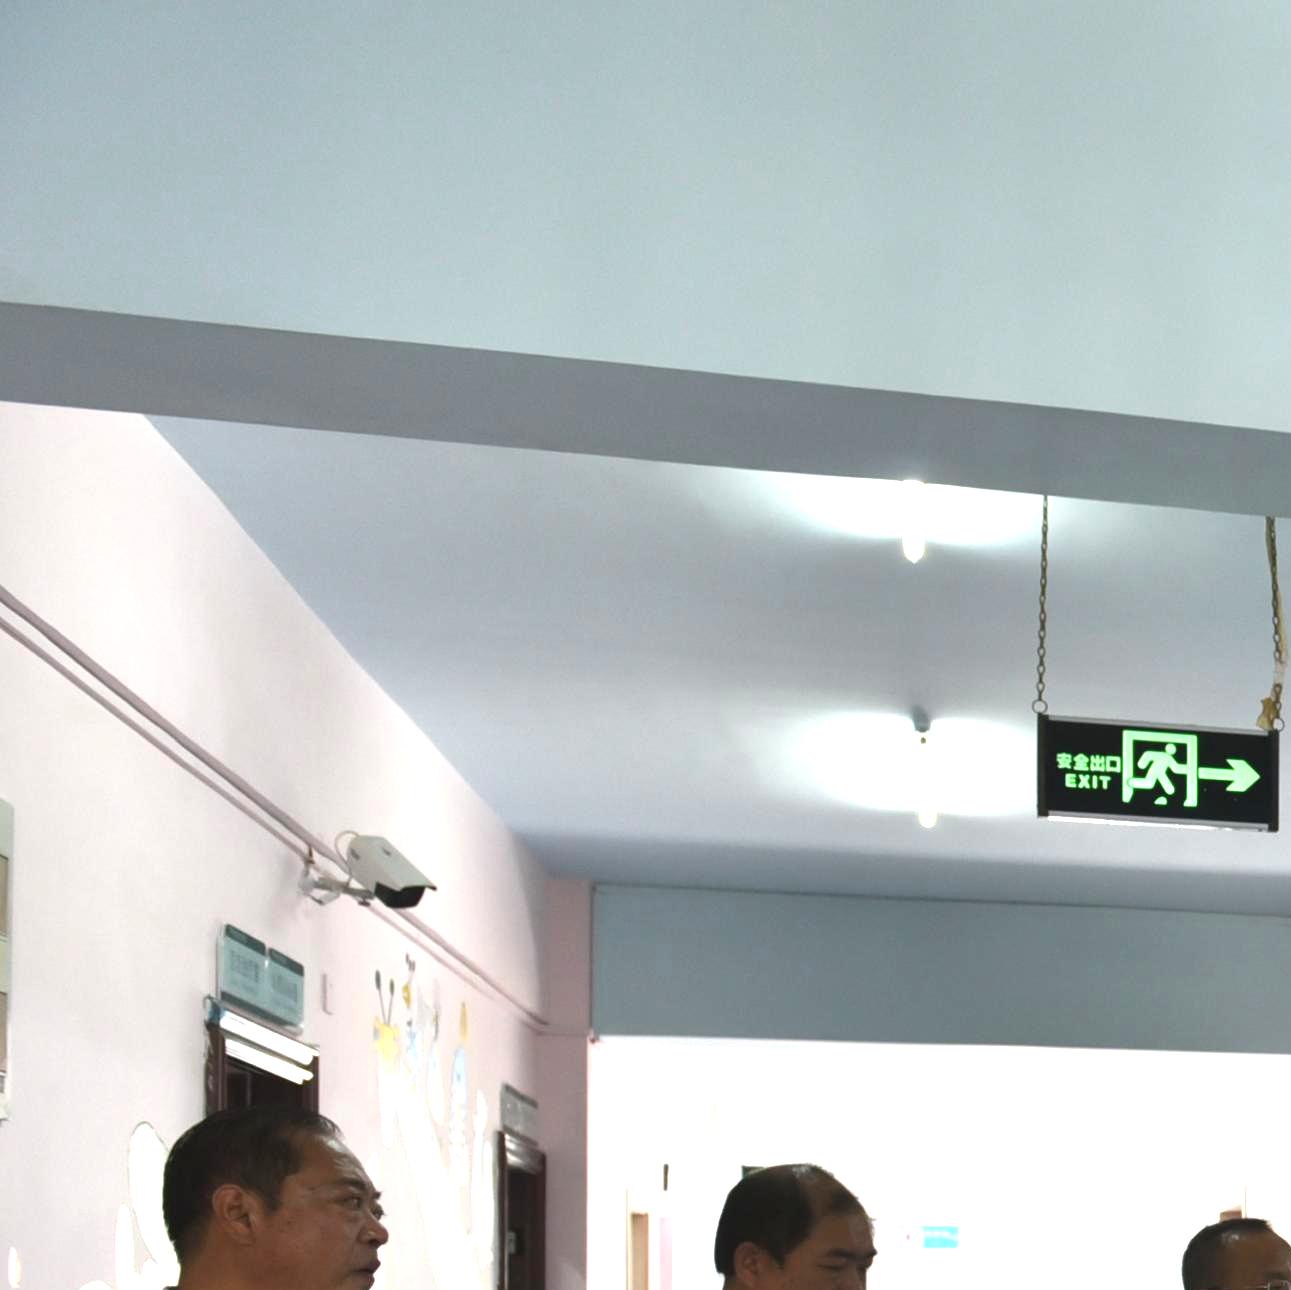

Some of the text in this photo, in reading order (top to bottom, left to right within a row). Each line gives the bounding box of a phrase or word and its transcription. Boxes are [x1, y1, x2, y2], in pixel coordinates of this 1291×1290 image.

[1056, 752, 1121, 773] 安全出口
[1065, 773, 1111, 790] EXIT
